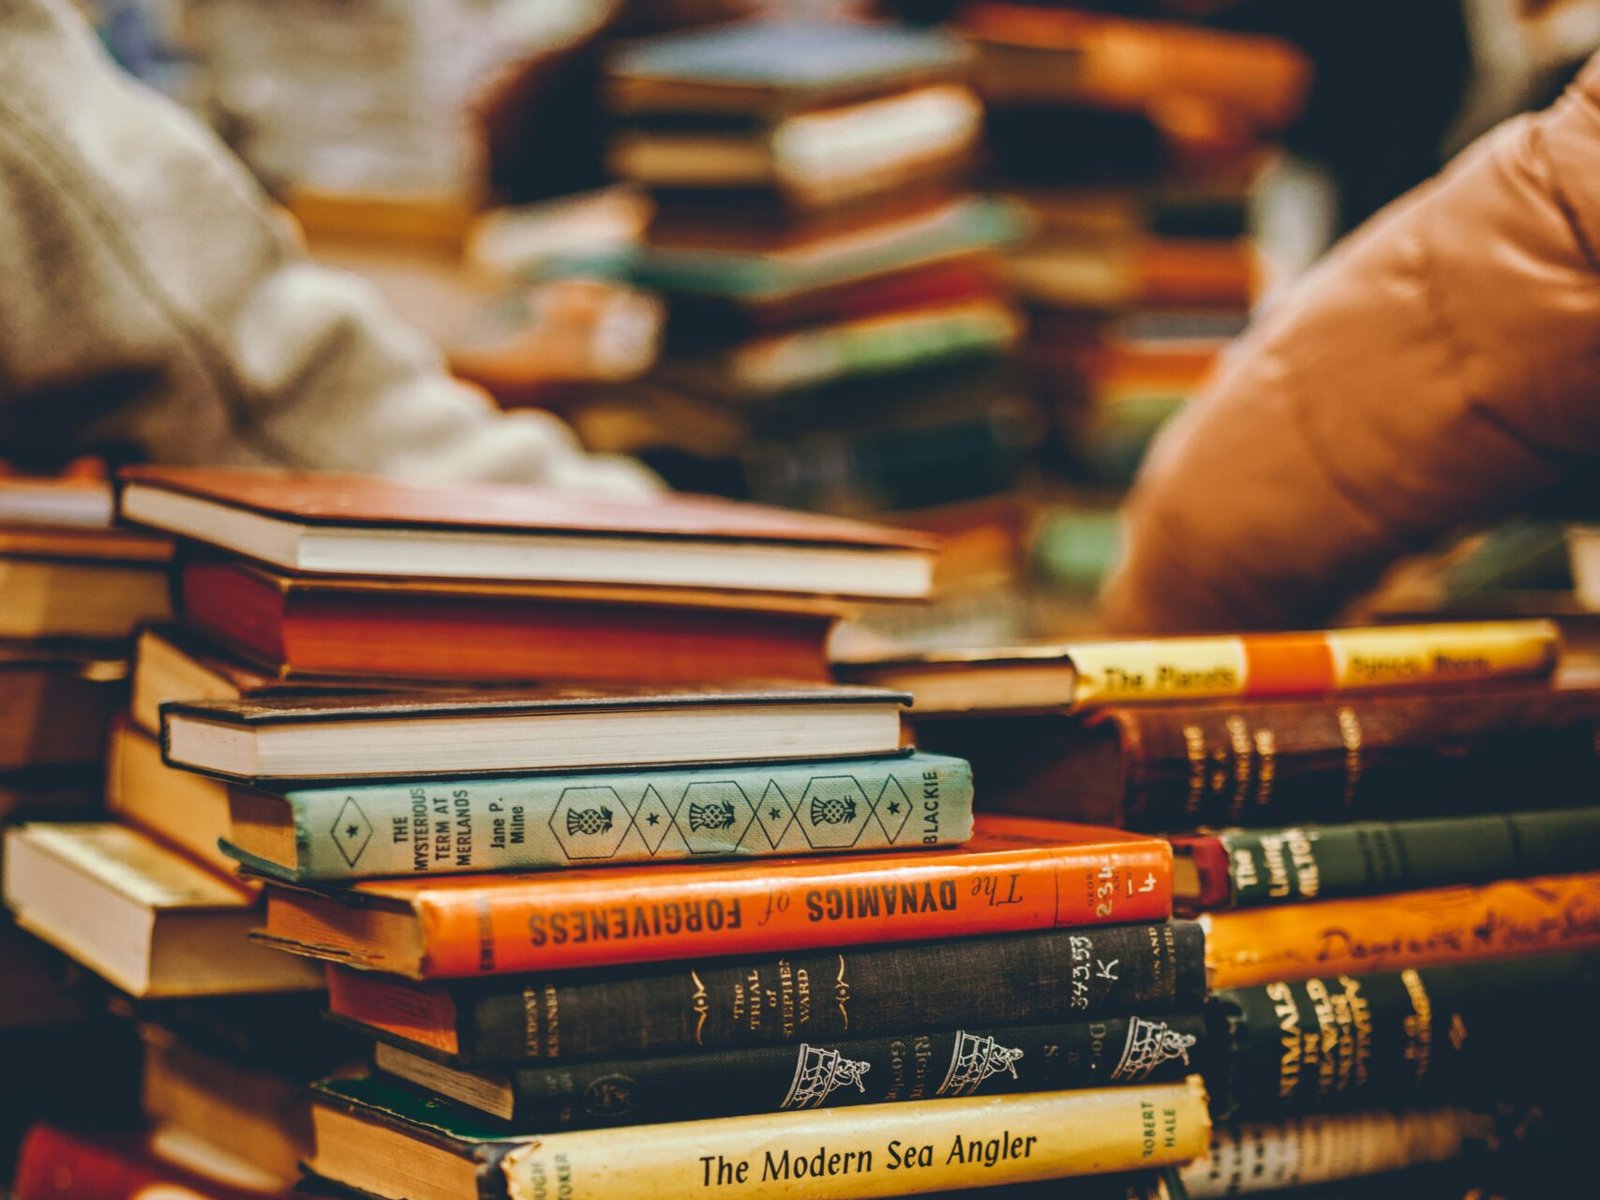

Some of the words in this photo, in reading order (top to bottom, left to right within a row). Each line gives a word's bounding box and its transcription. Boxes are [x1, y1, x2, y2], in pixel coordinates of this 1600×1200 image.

[433, 797, 449, 814] AT
[489, 797, 504, 812] P.
[922, 770, 939, 844] BLACKIE
[393, 817, 408, 843] THE
[410, 788, 429, 871] MYSTERIOUS
[435, 821, 450, 861] TERM
[453, 790, 472, 866] MERLANDS
[490, 819, 505, 848] Jane
[511, 806, 524, 843] Milne
[808, 879, 959, 924] DYNAMICS
[971, 873, 1024, 907] The
[1138, 872, 1157, 892] 4
[529, 896, 741, 946] FORGIVENESS
[756, 888, 791, 929] of
[1096, 959, 1119, 980] K
[734, 984, 744, 1022] The
[747, 968, 760, 1031] TRIAL
[765, 988, 778, 1008] of
[798, 968, 811, 1024] WARD
[1141, 1103, 1155, 1157] ROBERT
[1163, 1109, 1176, 1147] HALE
[699, 1153, 749, 1189] The
[761, 1141, 873, 1184] Modern
[886, 1137, 934, 1171] Sea
[947, 1129, 1038, 1166] Angler
